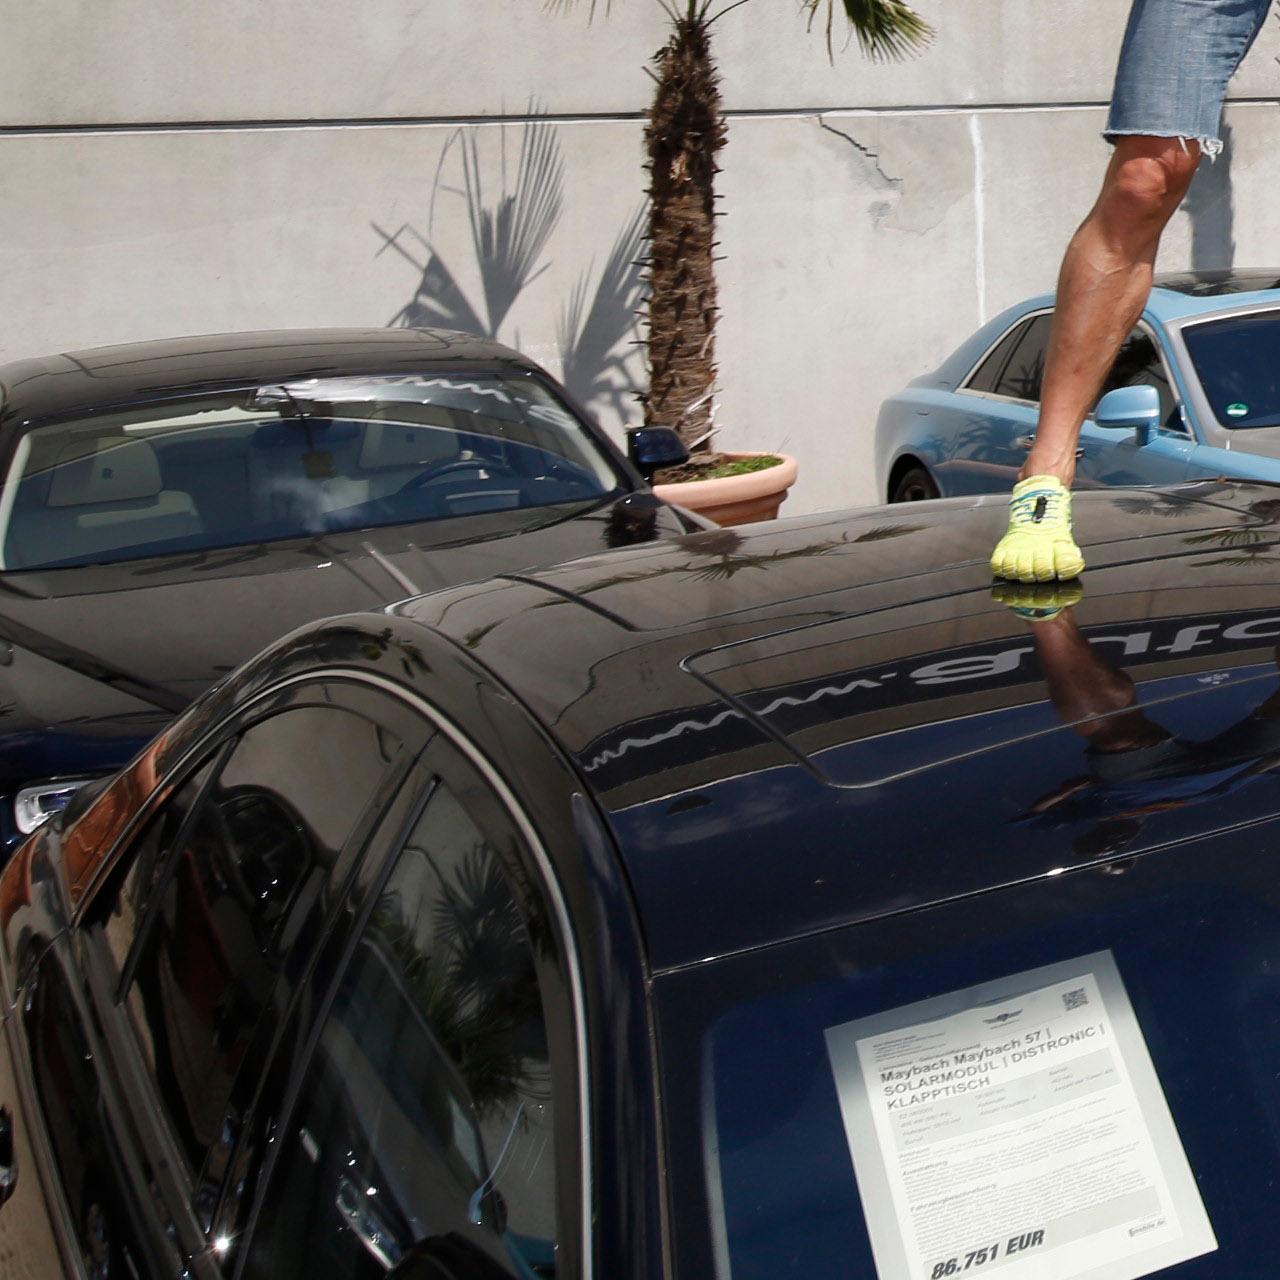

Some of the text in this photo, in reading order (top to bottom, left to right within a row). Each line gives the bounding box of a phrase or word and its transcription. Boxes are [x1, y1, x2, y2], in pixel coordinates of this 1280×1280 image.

[881, 1053, 950, 1083] Maybach
[954, 1038, 1021, 1065] Maybach
[1025, 1031, 1042, 1044] 57
[884, 1063, 999, 1096] SOLARMODUL
[1012, 1027, 1096, 1063] DISTRONIC
[887, 1077, 991, 1110] KLAPPTISCH
[931, 1229, 1045, 1280] 86.751 EUR
